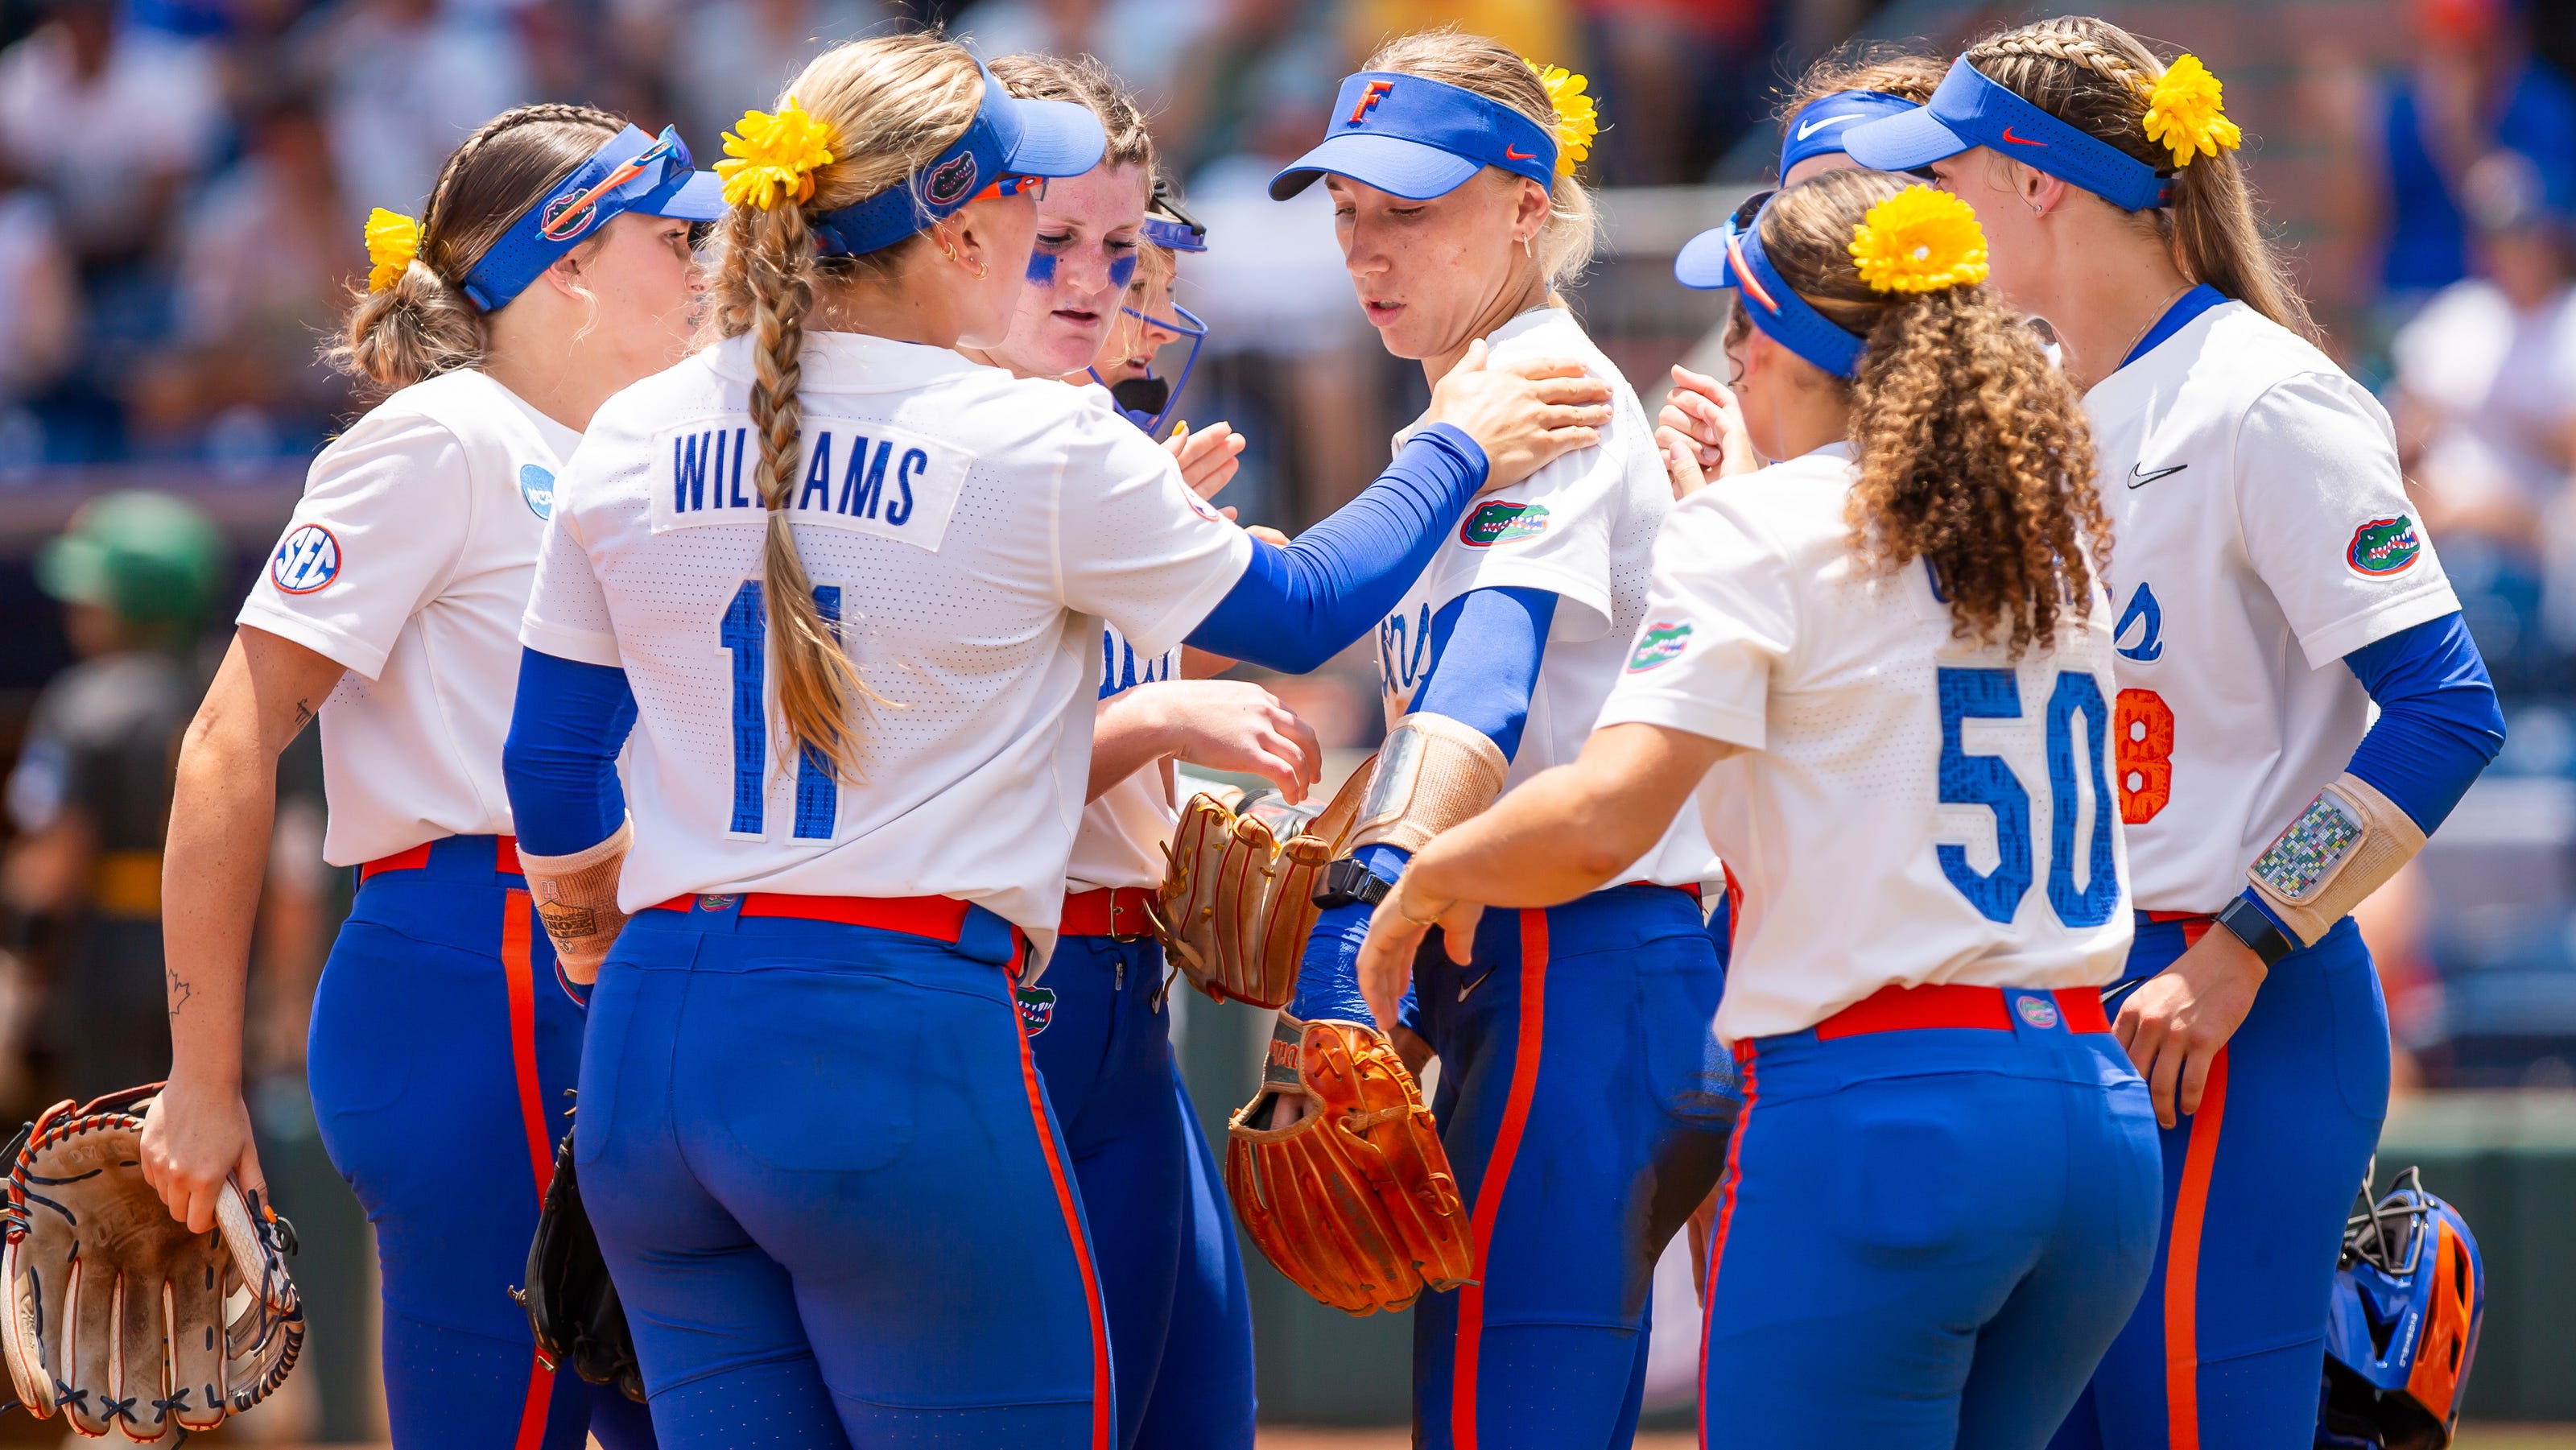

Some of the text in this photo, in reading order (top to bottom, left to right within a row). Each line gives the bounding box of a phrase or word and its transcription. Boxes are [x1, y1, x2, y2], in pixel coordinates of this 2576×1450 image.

[1348, 80, 1395, 125] F
[674, 428, 928, 527] WILAMS
[275, 527, 336, 589] SEC
[1938, 667, 2121, 928] 50
